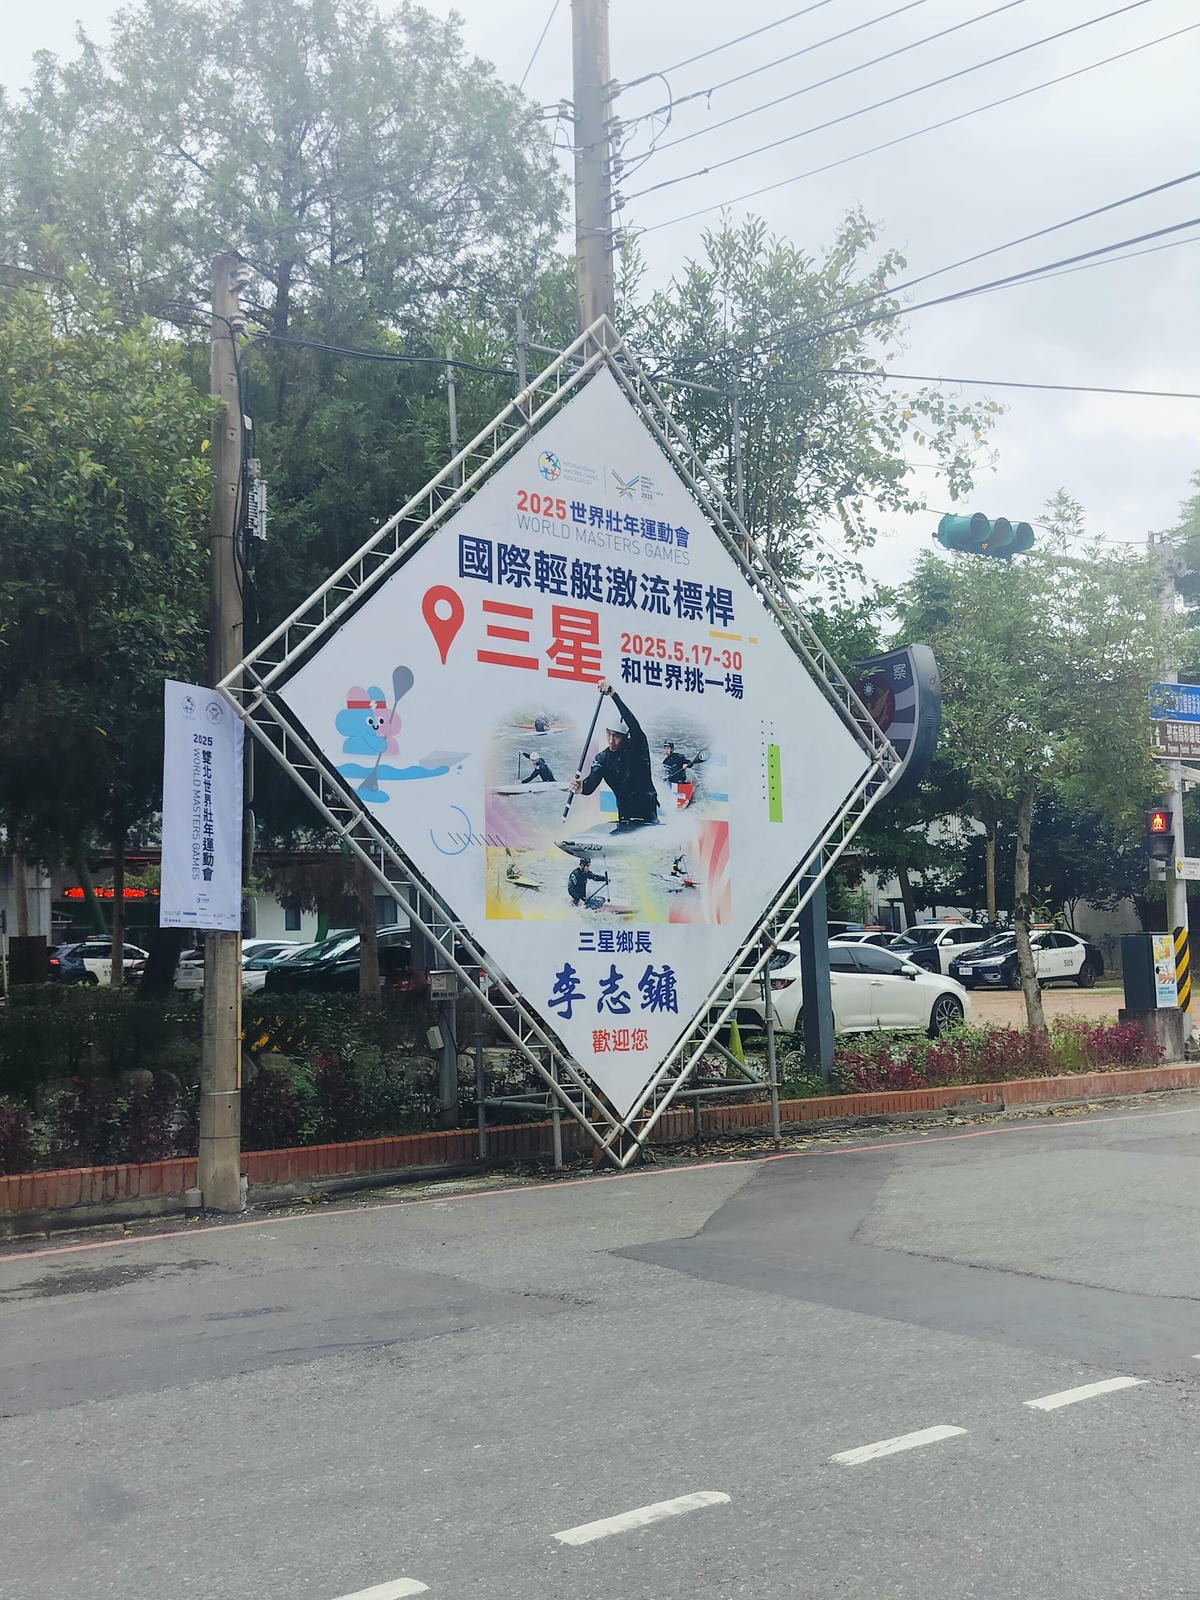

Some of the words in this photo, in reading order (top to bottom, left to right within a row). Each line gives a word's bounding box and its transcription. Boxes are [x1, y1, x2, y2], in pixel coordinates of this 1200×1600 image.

[517, 490, 567, 520] 2025
[570, 501, 690, 548] 世界壯年運動會
[517, 514, 570, 540] WORLD
[575, 526, 640, 556] MASTERS
[644, 546, 690, 566] GAMES
[458, 534, 735, 627] 國際輕艇激流標桿
[477, 600, 605, 684] 三星
[620, 633, 742, 670] 2025.5.17-30
[621, 657, 744, 700] 和世界挑一場
[193, 733, 213, 746] 2025
[193, 748, 201, 786] WORLD
[192, 789, 201, 840] MASTERS
[202, 749, 215, 881] 雙北世界壯年運動會
[191, 842, 201, 880] GAMES
[578, 930, 652, 953] 三星鄉長
[548, 962, 679, 1020] 李志鏞
[592, 1028, 649, 1053] 歡迎您
